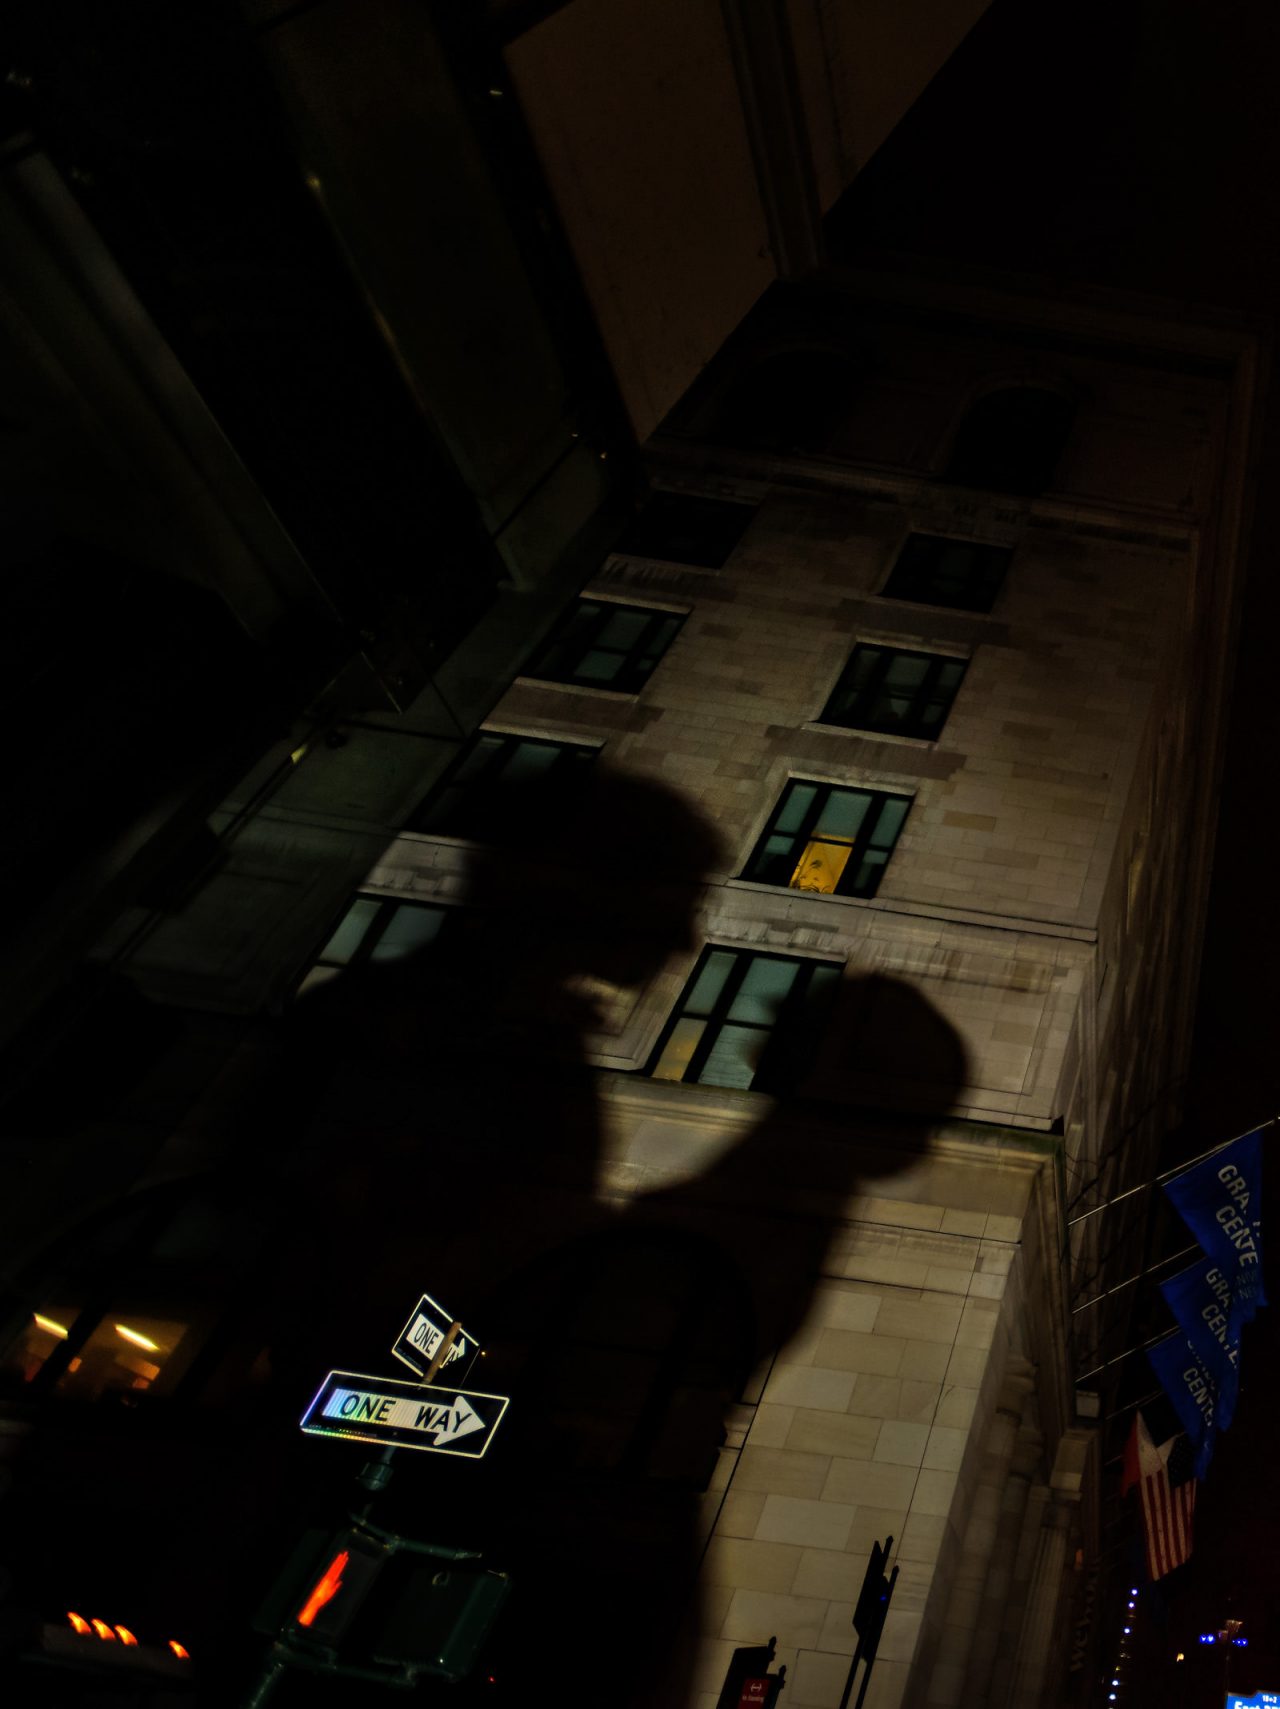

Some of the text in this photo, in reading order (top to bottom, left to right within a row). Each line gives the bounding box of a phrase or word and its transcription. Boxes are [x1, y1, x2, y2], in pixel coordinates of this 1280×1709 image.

[1215, 1205, 1259, 1267] CENTE
[413, 1322, 440, 1355] ONE
[340, 1394, 472, 1433] ONE WAY
